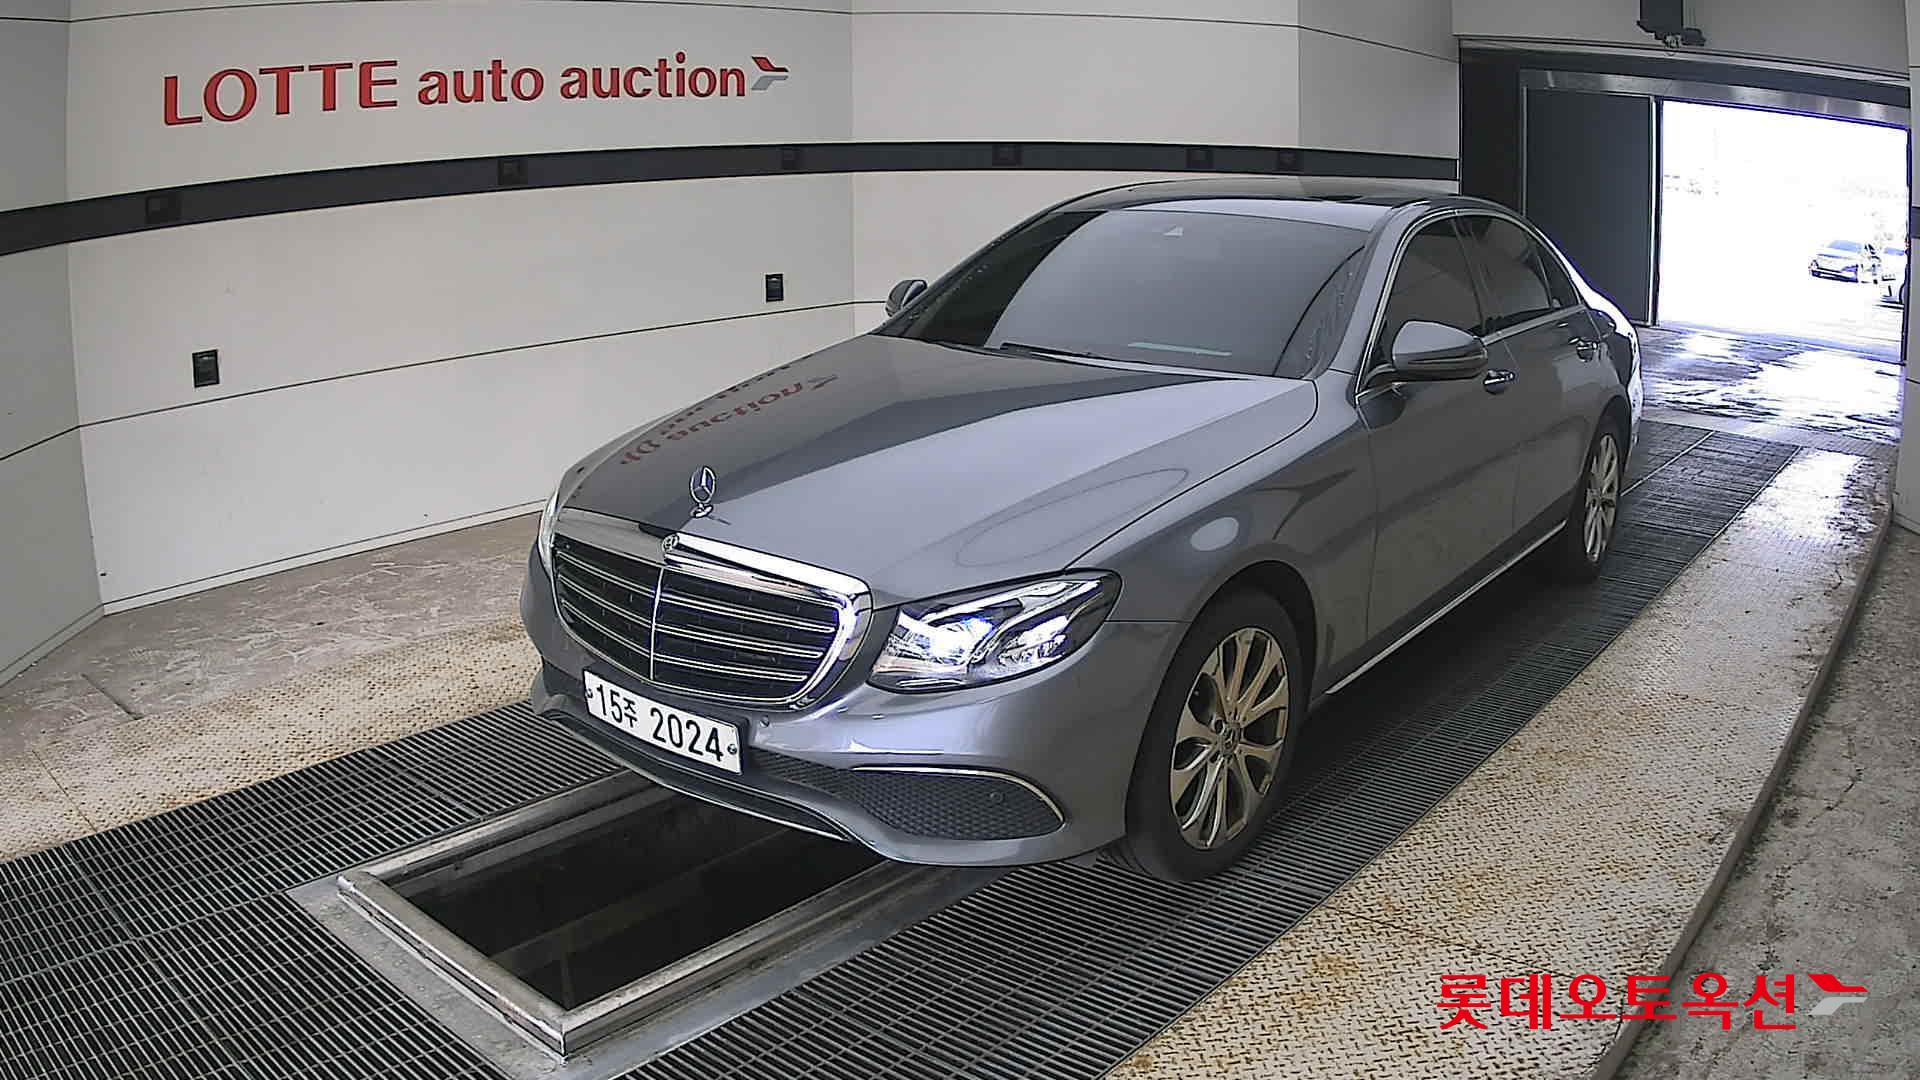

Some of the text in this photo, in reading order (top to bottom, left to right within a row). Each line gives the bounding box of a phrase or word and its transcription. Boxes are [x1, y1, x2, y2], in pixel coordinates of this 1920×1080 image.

[163, 51, 747, 126] LOTTE auto auction
[596, 683, 724, 762] 15주 2024
